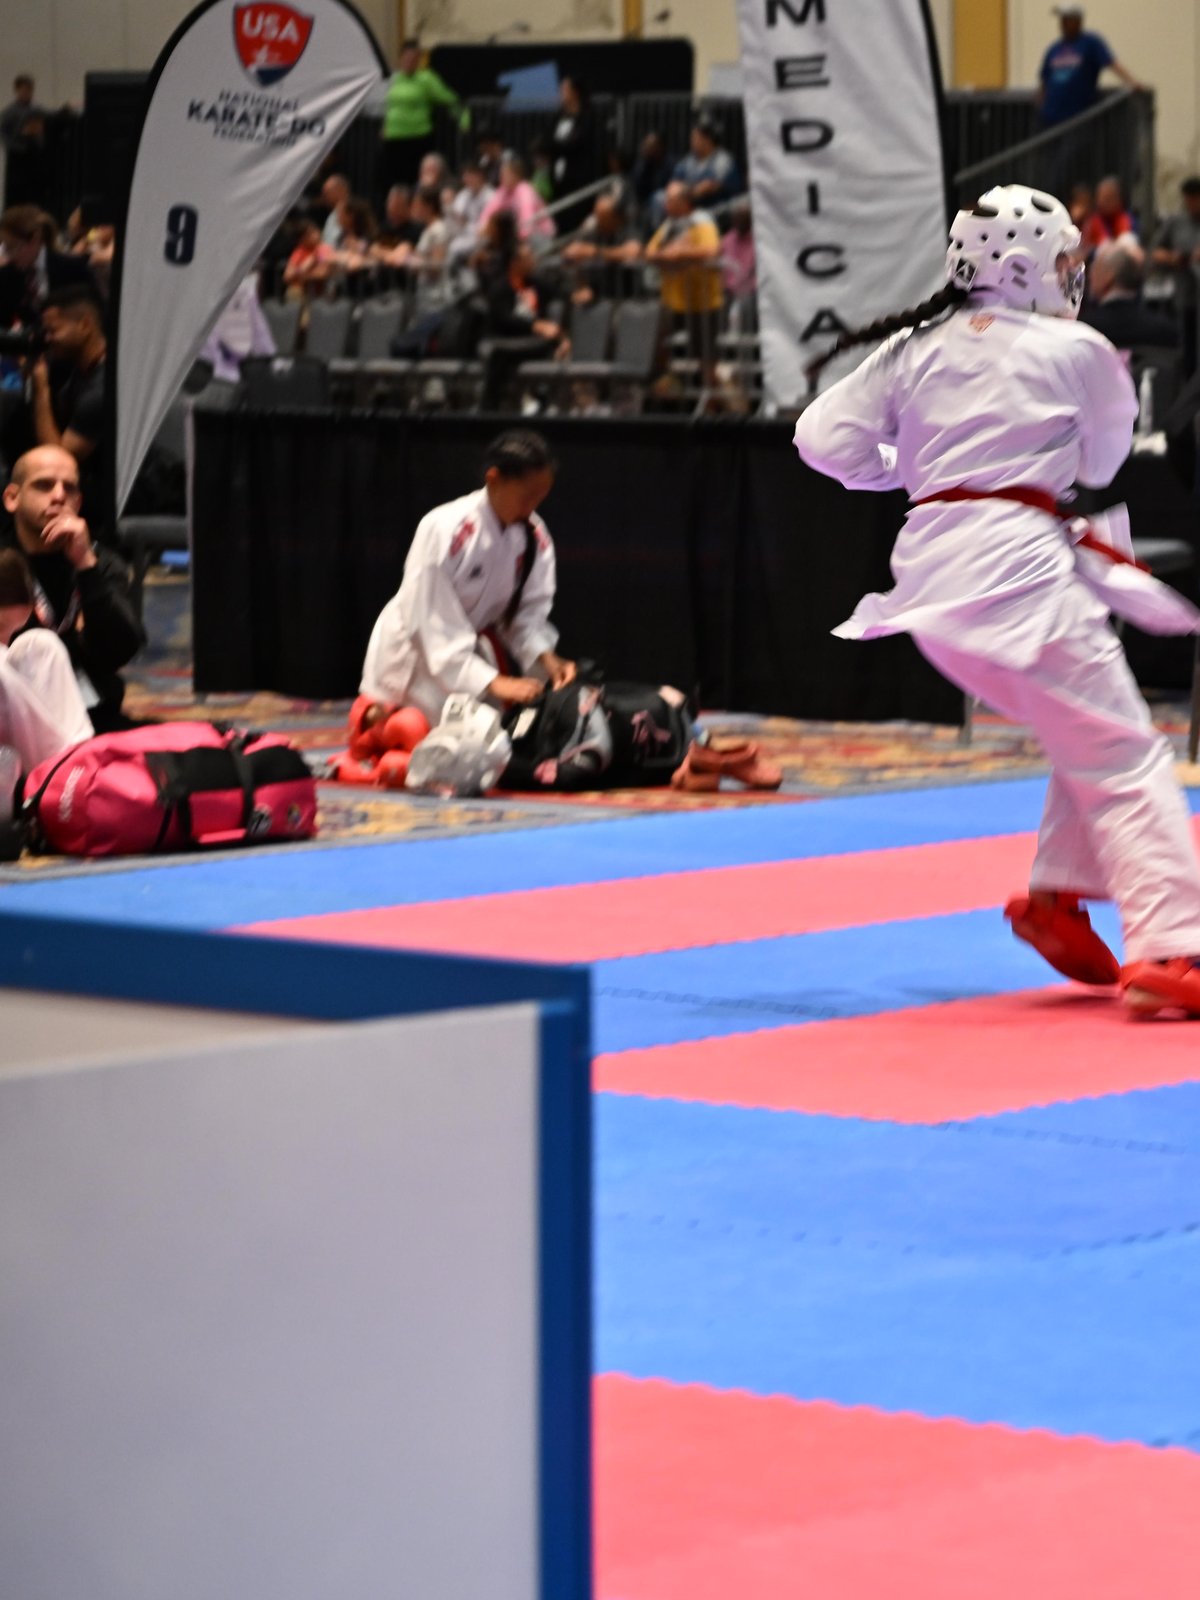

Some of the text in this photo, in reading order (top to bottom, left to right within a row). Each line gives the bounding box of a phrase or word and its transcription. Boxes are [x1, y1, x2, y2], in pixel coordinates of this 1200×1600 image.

[243, 10, 299, 43] USA
[218, 89, 298, 111] NATIONAL
[164, 203, 197, 266] 9
